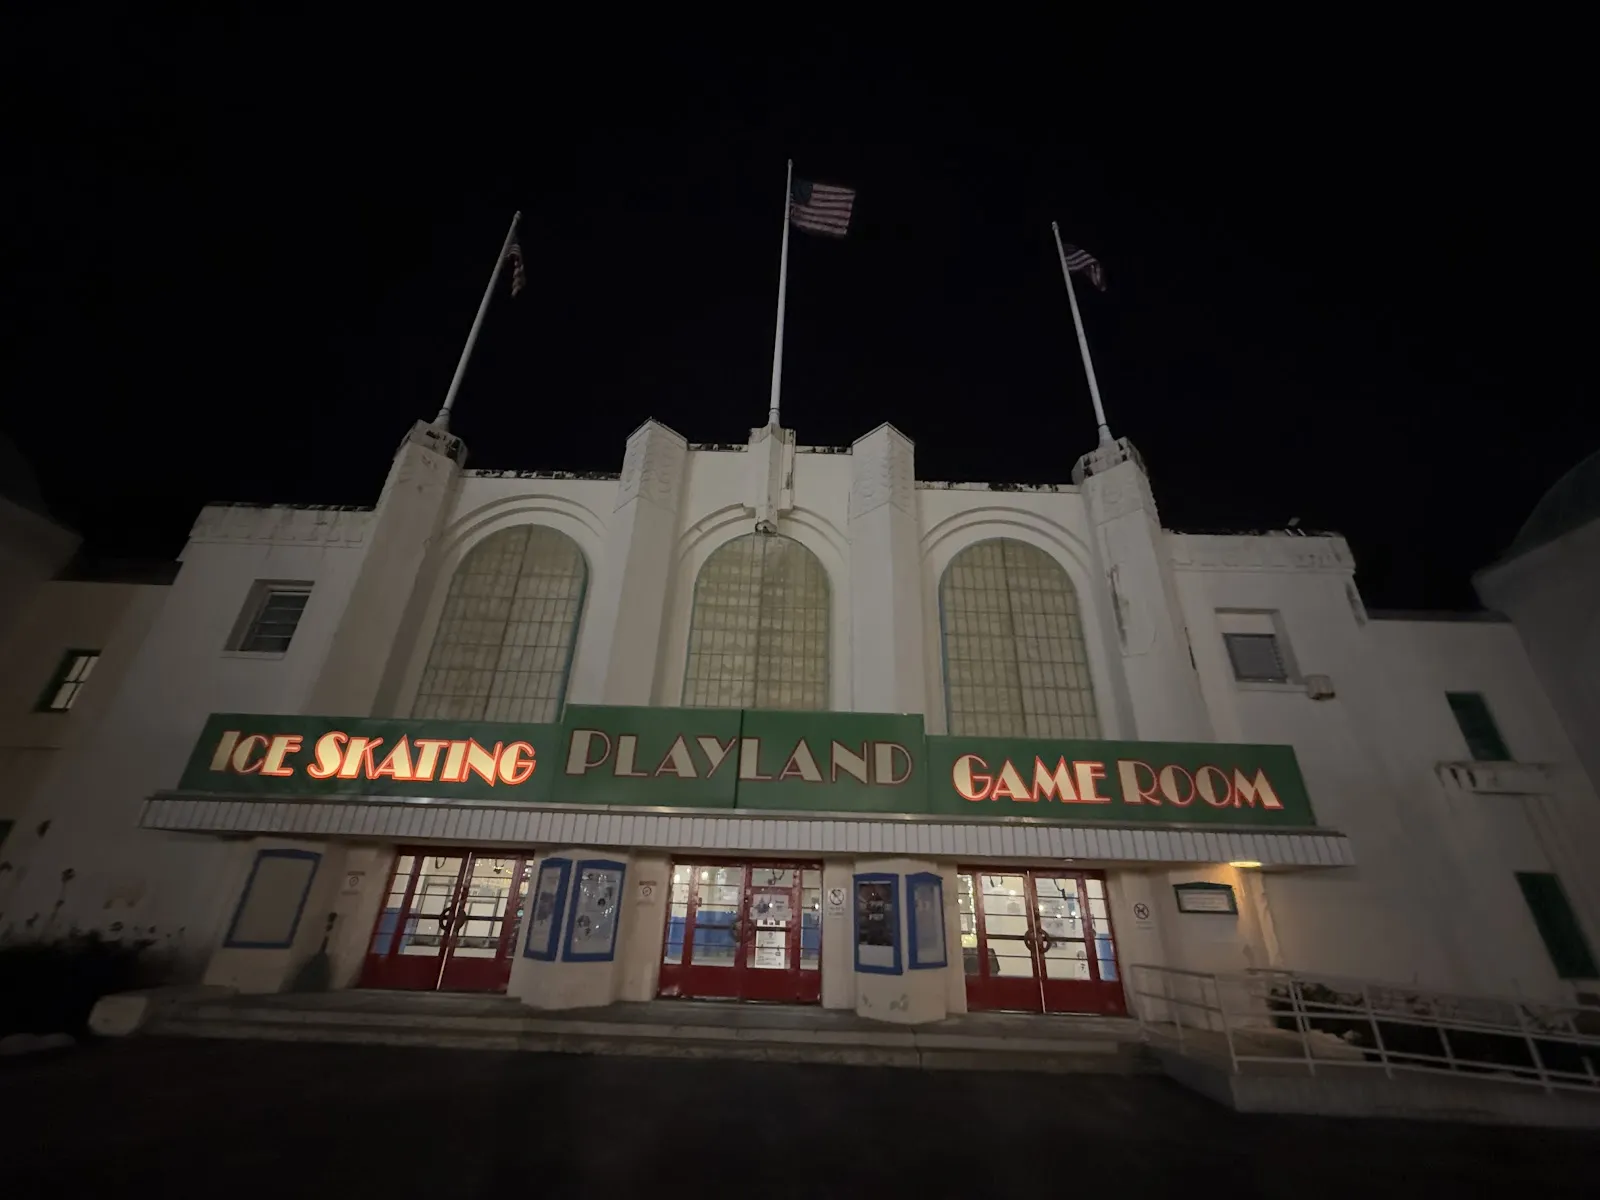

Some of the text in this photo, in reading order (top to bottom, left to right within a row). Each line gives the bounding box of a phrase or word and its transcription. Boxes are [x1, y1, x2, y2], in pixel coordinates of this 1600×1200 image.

[209, 730, 537, 787] ICE SKATING
[565, 730, 914, 785] PLAYLAND
[952, 754, 1284, 810] GAME ROOM
